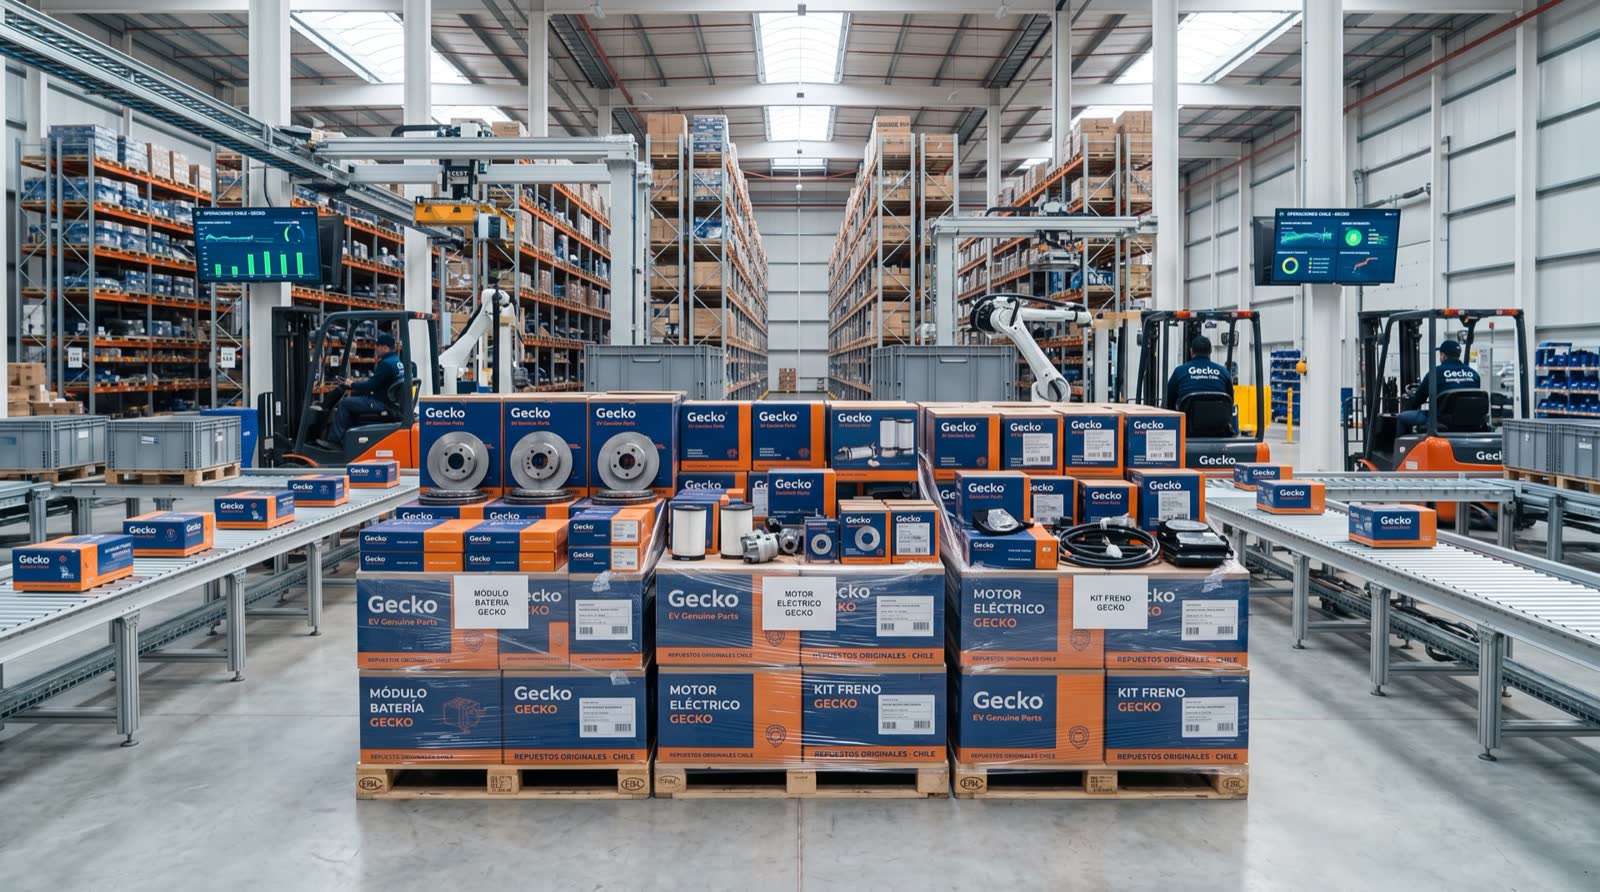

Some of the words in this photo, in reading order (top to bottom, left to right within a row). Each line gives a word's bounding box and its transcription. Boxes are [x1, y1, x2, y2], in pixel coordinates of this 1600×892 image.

[1189, 367, 1220, 377] Gecko
[426, 407, 465, 418] Gecko
[511, 407, 550, 418] Gecko
[596, 408, 636, 418] Gecko
[688, 411, 725, 422] Gecko
[759, 411, 797, 421] Gecko
[838, 413, 872, 422] Gecko
[942, 422, 976, 431] Gecko
[1011, 422, 1041, 431] Gecko
[1072, 420, 1102, 430] Gecko
[1134, 420, 1164, 429] Gecko
[1200, 455, 1236, 464] Gecko
[686, 480, 721, 489] Gecko
[776, 479, 811, 488] Gecko
[968, 483, 1004, 492] Gecko
[1150, 481, 1181, 490] Gecko
[129, 526, 156, 534] Gecko
[187, 523, 201, 533] Gecko
[19, 555, 49, 564] Gecko
[532, 589, 561, 602] cko
[838, 584, 870, 598] cko
[974, 589, 1021, 599] MOTOR
[668, 590, 738, 607] Gecko
[368, 596, 437, 613] Gecko
[974, 602, 1044, 614] ELÉCTRICO
[974, 618, 1016, 628] GECKO
[370, 686, 427, 698] MÓDULO
[514, 686, 571, 700] Gecko
[670, 685, 716, 694] MOTOR
[814, 685, 835, 694] KIT
[838, 685, 881, 694] FRENO
[1119, 688, 1138, 697] KIT
[1142, 688, 1186, 697] FRENO
[670, 697, 740, 710] ELÉCTRICO
[814, 699, 857, 708] GECKO
[974, 691, 1043, 709] Gecko
[371, 699, 424, 712] BATERÍA
[515, 705, 557, 714] GECKO
[1118, 702, 1161, 712] GECKO
[370, 718, 413, 727] GECKO
[670, 714, 712, 724] GECKO
